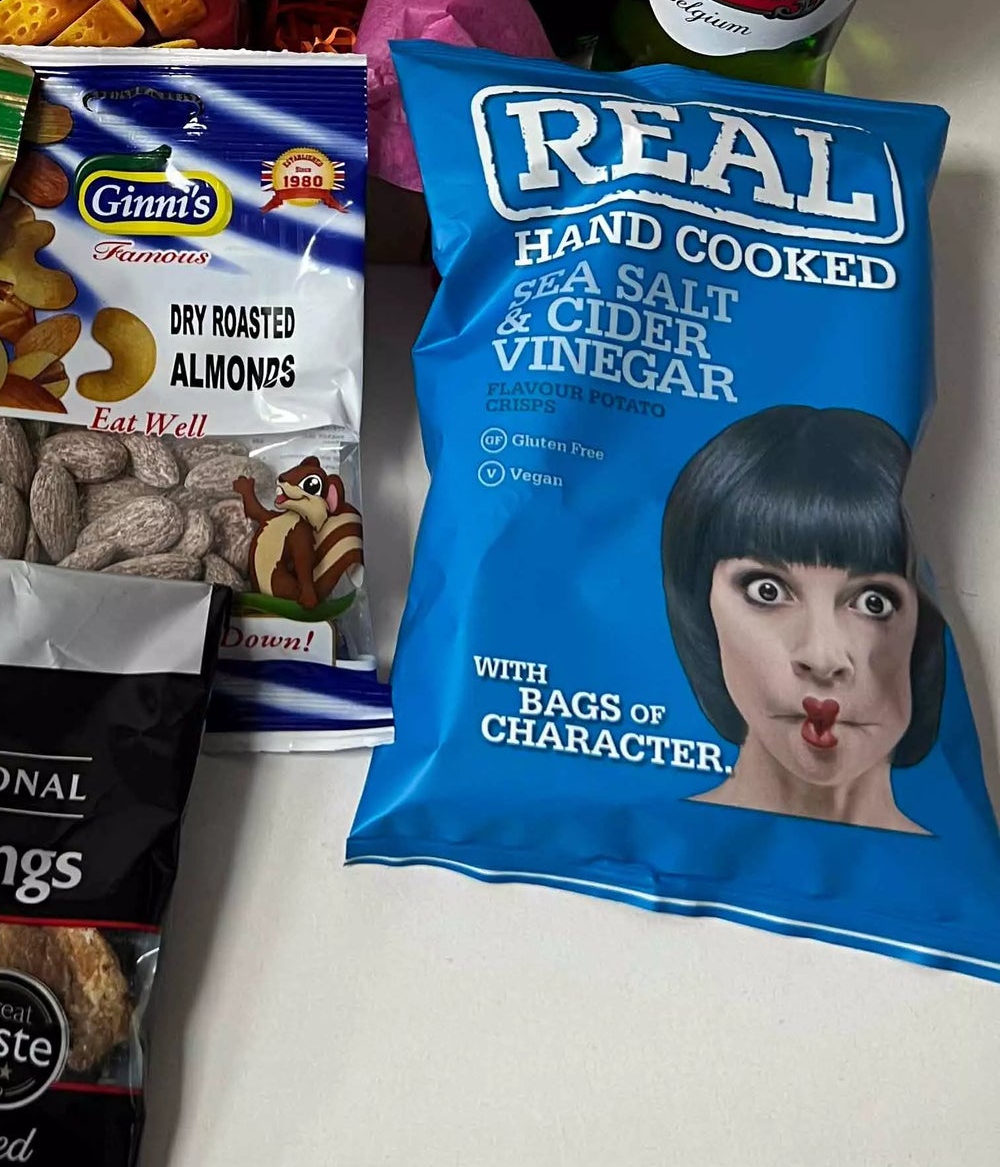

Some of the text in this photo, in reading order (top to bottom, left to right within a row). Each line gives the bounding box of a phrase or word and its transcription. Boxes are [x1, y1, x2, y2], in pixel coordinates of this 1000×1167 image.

[506, 98, 876, 222] REAL
[284, 176, 322, 187] 1980
[92, 184, 211, 219] Ginni's
[92, 241, 211, 266] Famous
[514, 210, 897, 291] HAND COOKED
[512, 260, 739, 324] SEA SALT
[170, 303, 295, 339] DRY ROASTED
[497, 296, 711, 360] & CIDER
[170, 352, 296, 391] ALMONDS
[492, 336, 738, 403] VINEGAR
[486, 397, 556, 414] CRISPS
[487, 382, 667, 418] FLAVOUR POTATO
[91, 406, 209, 438] Eat Well
[512, 434, 604, 460] Gluten Free
[510, 467, 563, 486] Vegan
[220, 626, 315, 652] Down!
[474, 655, 548, 684] WITH
[519, 687, 666, 725] BAGS OF
[481, 713, 733, 774] CHARACTER.
